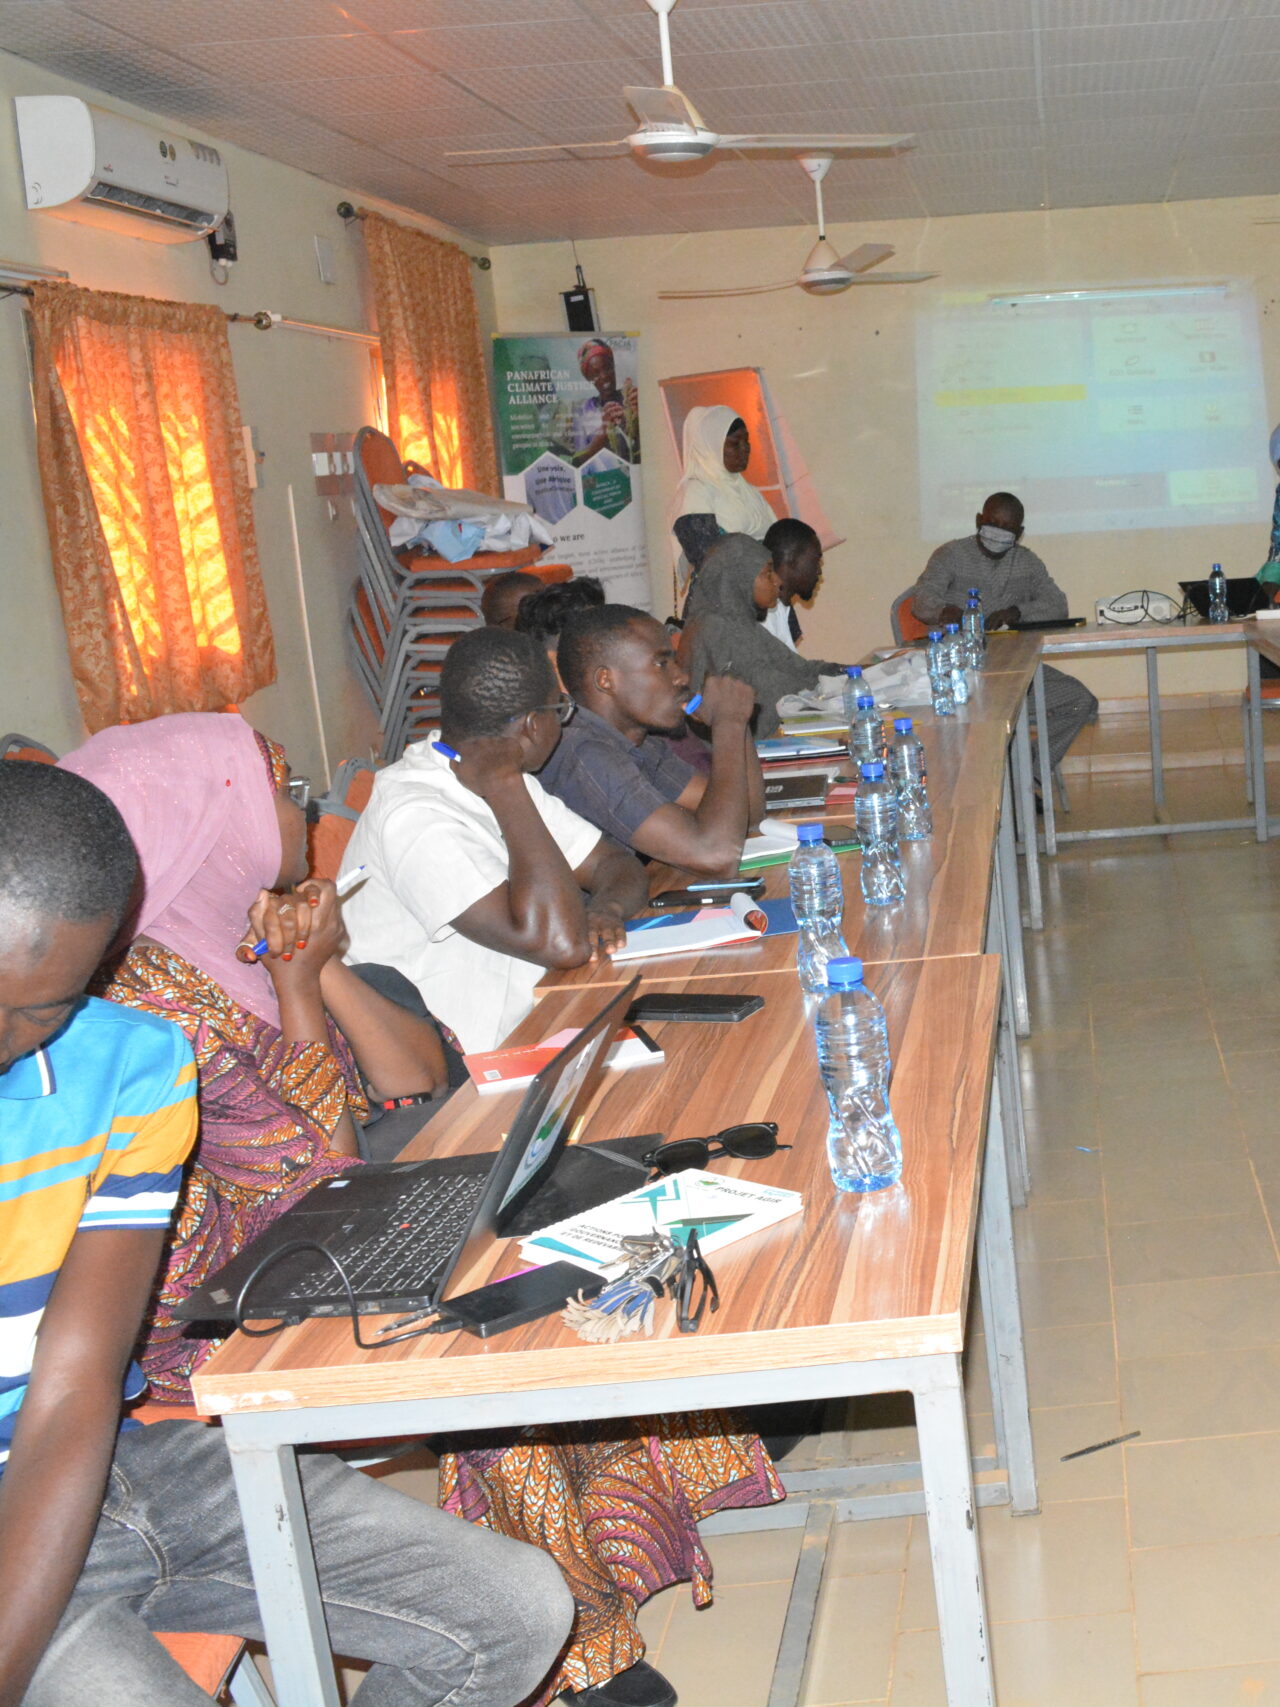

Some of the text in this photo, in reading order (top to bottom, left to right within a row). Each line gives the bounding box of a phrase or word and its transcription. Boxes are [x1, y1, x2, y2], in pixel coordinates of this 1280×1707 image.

[506, 369, 570, 380] PANAFRICAN
[507, 382, 553, 392] CLIMATE
[508, 393, 558, 405] ALLIANCE
[572, 533, 585, 541] are
[715, 1186, 757, 1198] PROJET
[570, 1228, 620, 1244] GOUVERNANC
